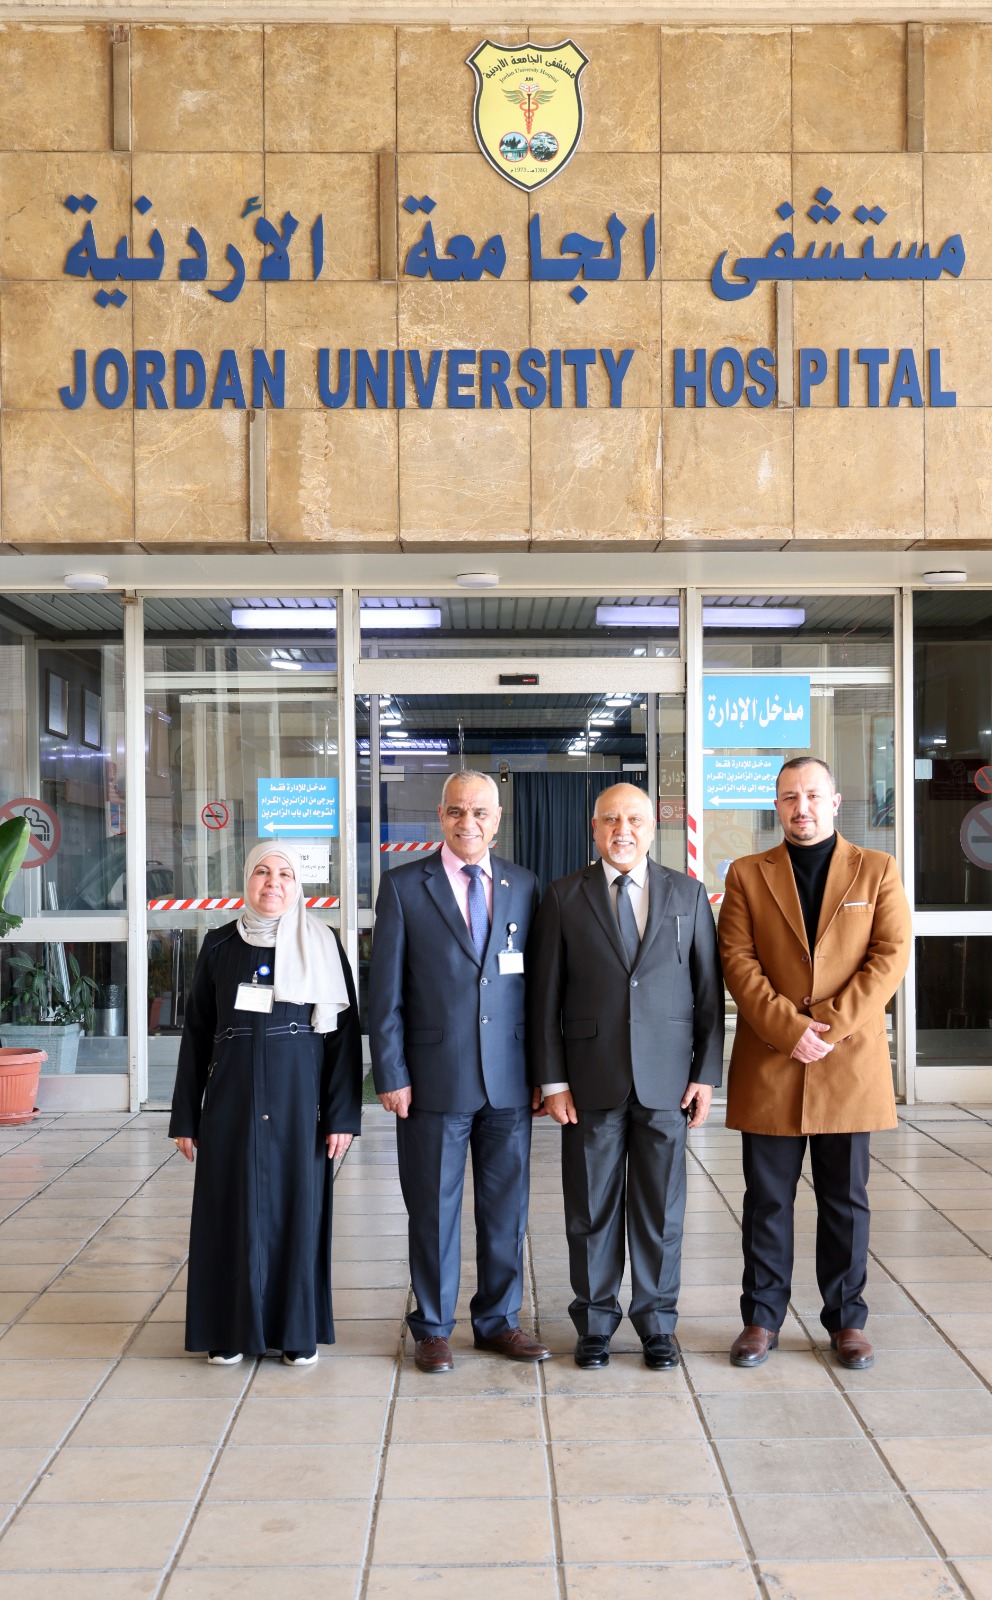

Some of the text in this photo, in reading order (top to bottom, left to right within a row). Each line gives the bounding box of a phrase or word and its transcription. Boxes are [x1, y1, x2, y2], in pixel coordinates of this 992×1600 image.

[511, 54, 542, 65] الجامعة
[545, 57, 576, 79] مستشفى
[499, 71, 515, 84] Jordan
[539, 68, 559, 84] Hospital
[64, 187, 966, 308] مستشفى الجامعة الأردنية
[60, 347, 957, 409] JORDAN UNIVERSITY HOSPITAL
[707, 693, 804, 730] مدخل الإدارة
[715, 759, 772, 770] مدخل للإدارة فقط
[706, 771, 726, 781] الكرام
[753, 772, 762, 781] من
[269, 782, 327, 794] مدخل للإدارة فقط
[735, 783, 747, 793] باب
[261, 795, 281, 806] الكرام
[308, 796, 317, 806] من
[316, 796, 335, 806] يرجى
[290, 808, 302, 818] باب
[312, 807, 336, 818] التوجه
